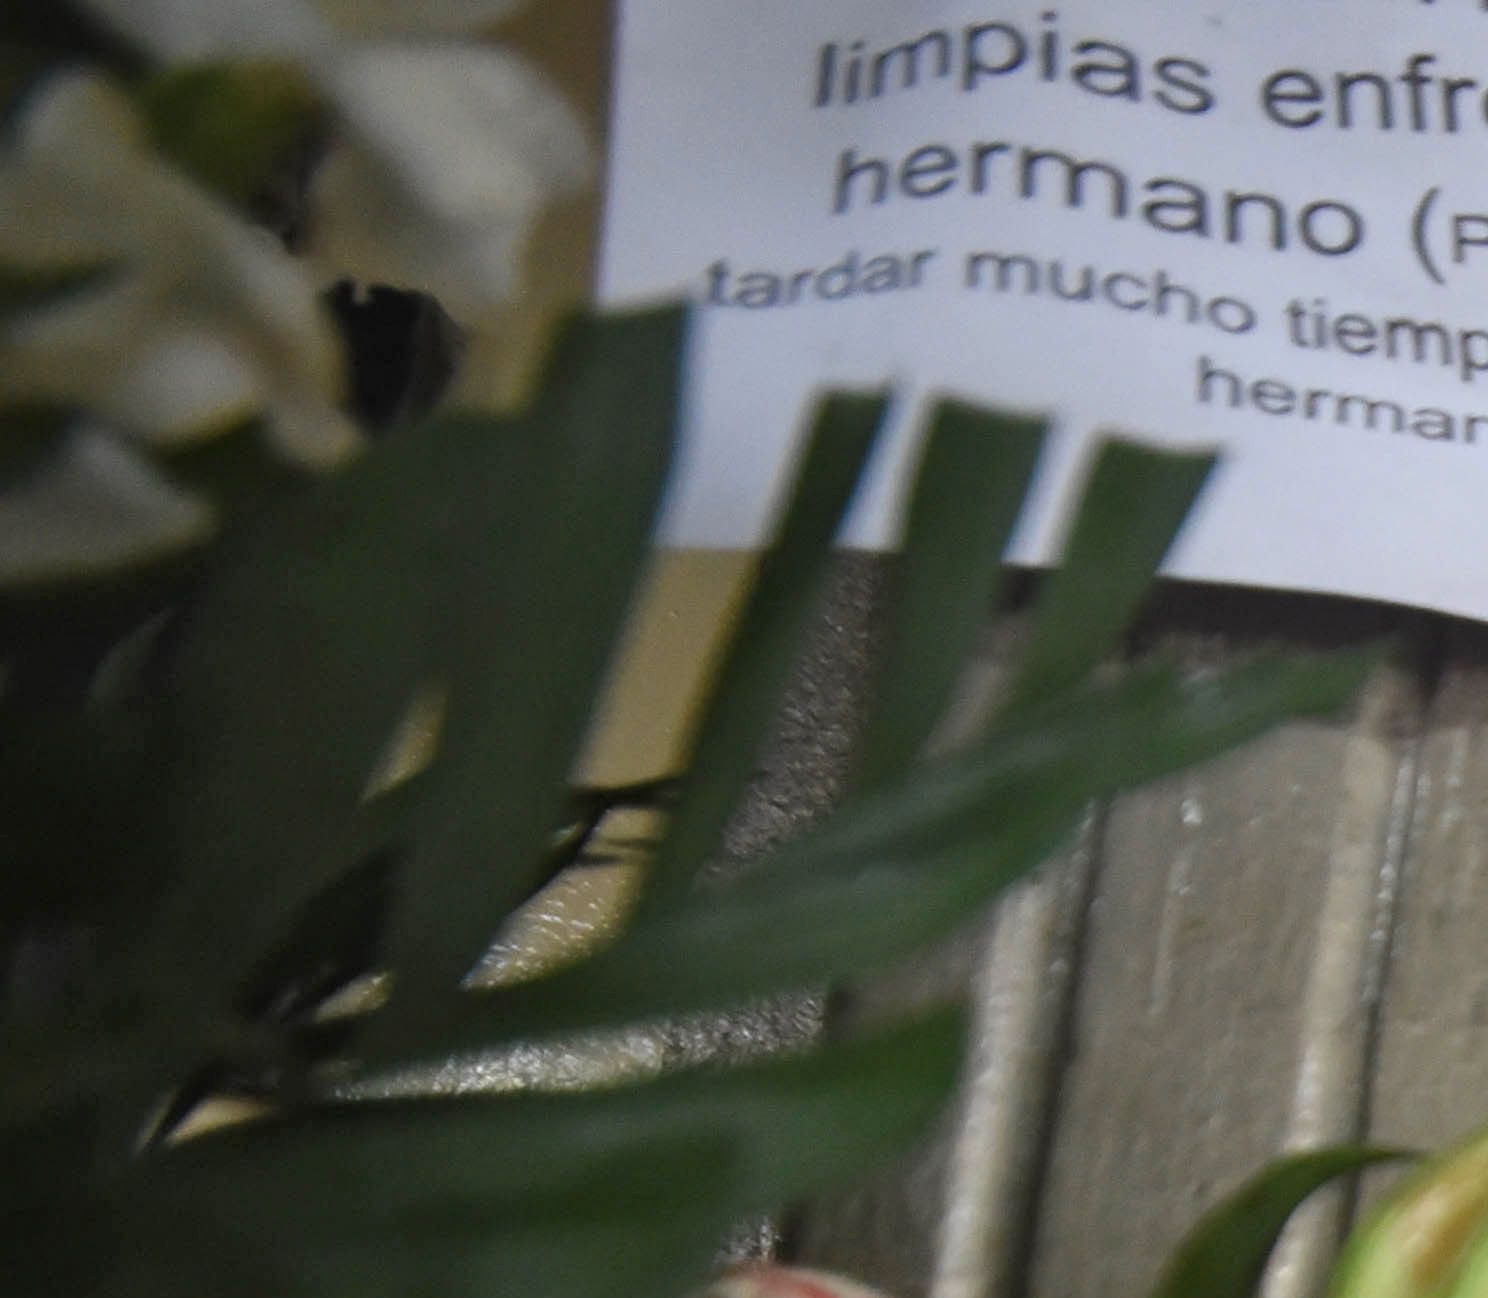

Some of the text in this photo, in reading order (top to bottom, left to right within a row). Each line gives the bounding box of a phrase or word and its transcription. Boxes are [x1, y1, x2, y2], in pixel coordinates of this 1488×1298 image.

[814, 11, 1217, 116] limpias
[832, 140, 1366, 256] hermano
[705, 248, 936, 308] tardar
[964, 252, 1257, 335] mucho
